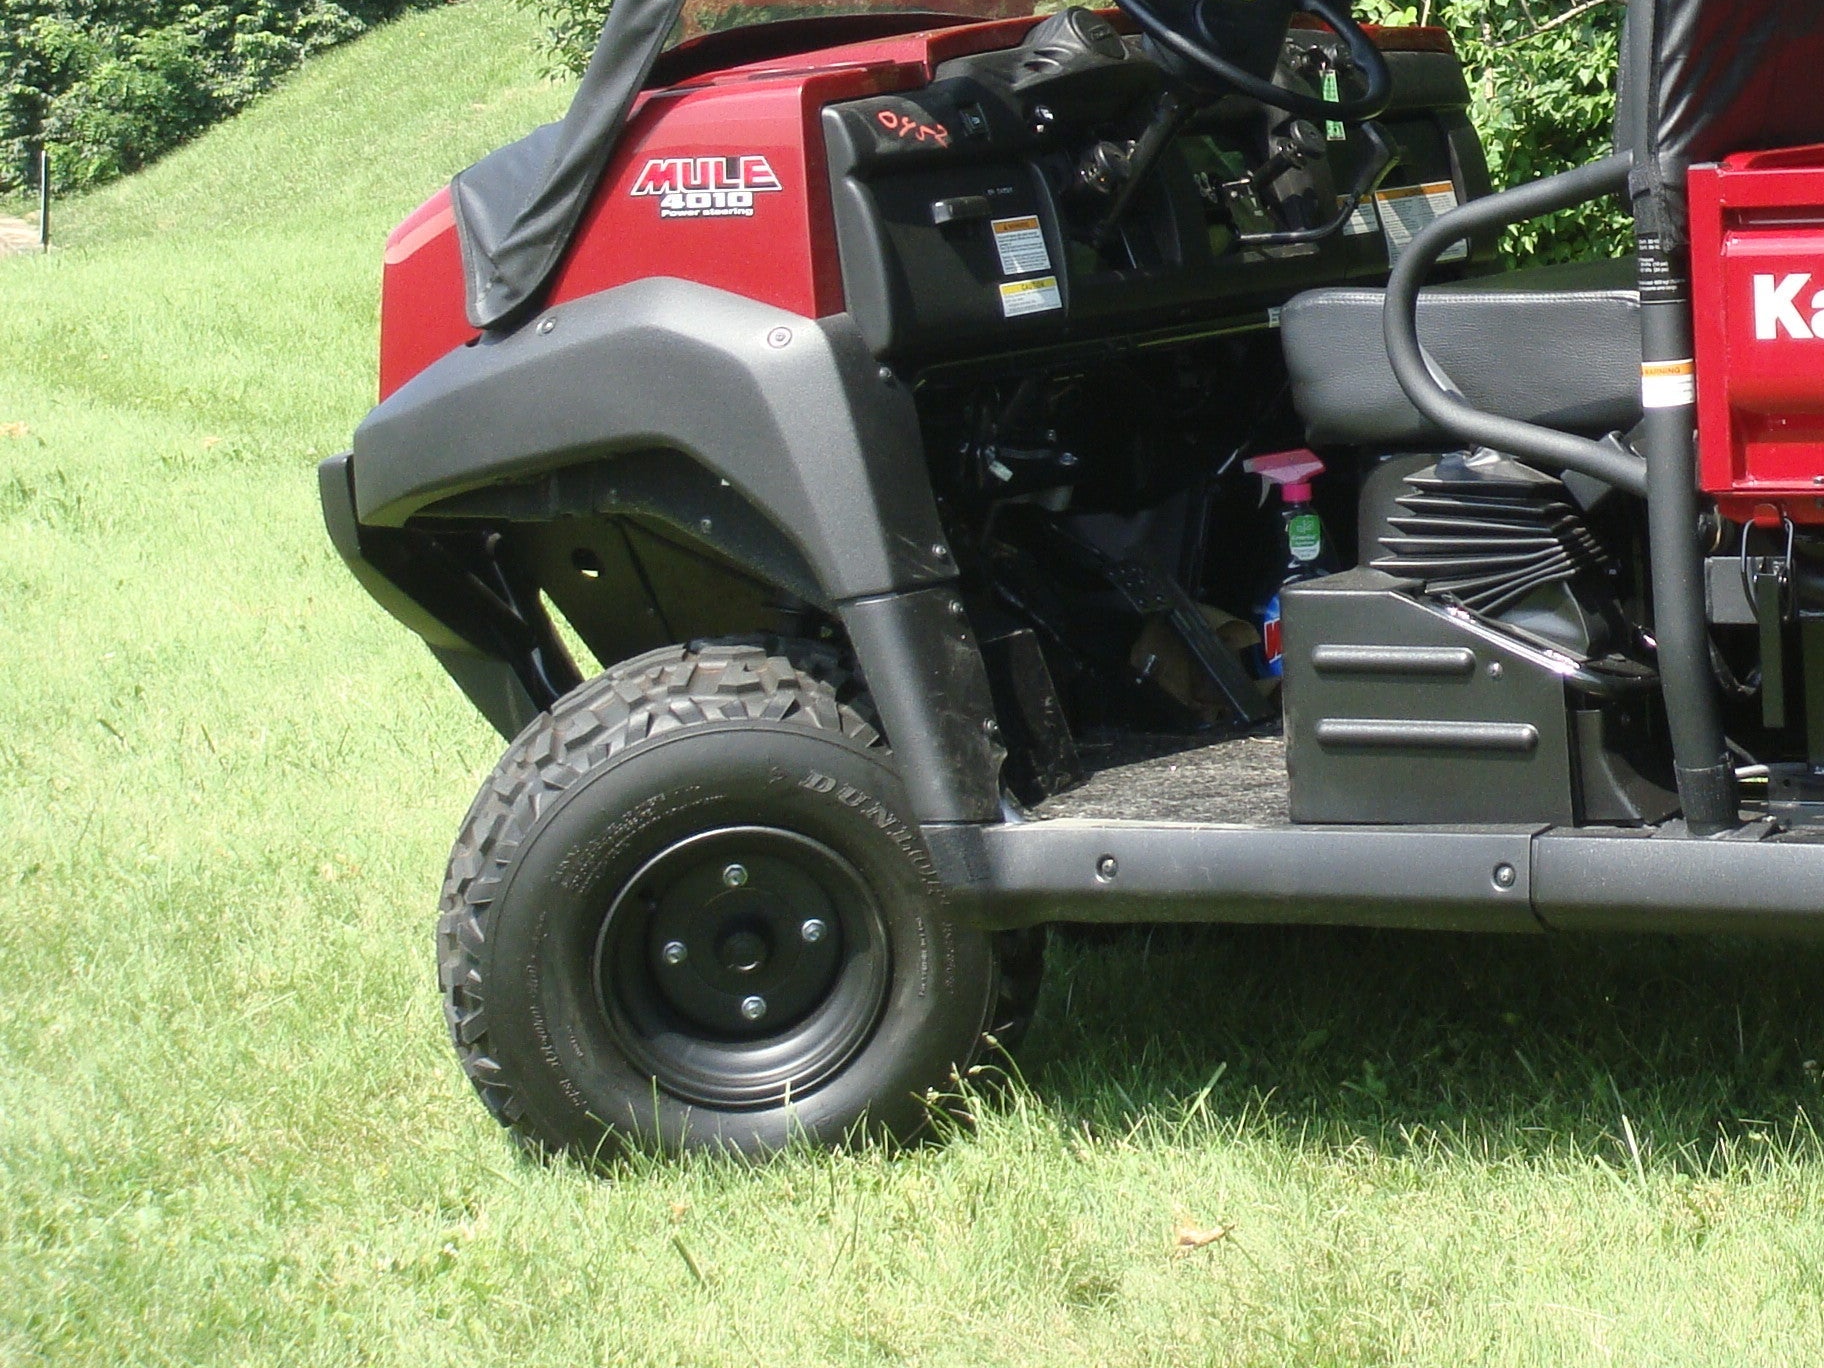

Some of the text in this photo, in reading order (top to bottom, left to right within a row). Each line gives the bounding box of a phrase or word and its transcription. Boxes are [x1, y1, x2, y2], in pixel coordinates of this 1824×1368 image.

[630, 155, 783, 196] MULE
[660, 191, 753, 209] 4010
[661, 207, 754, 218] Power steering
